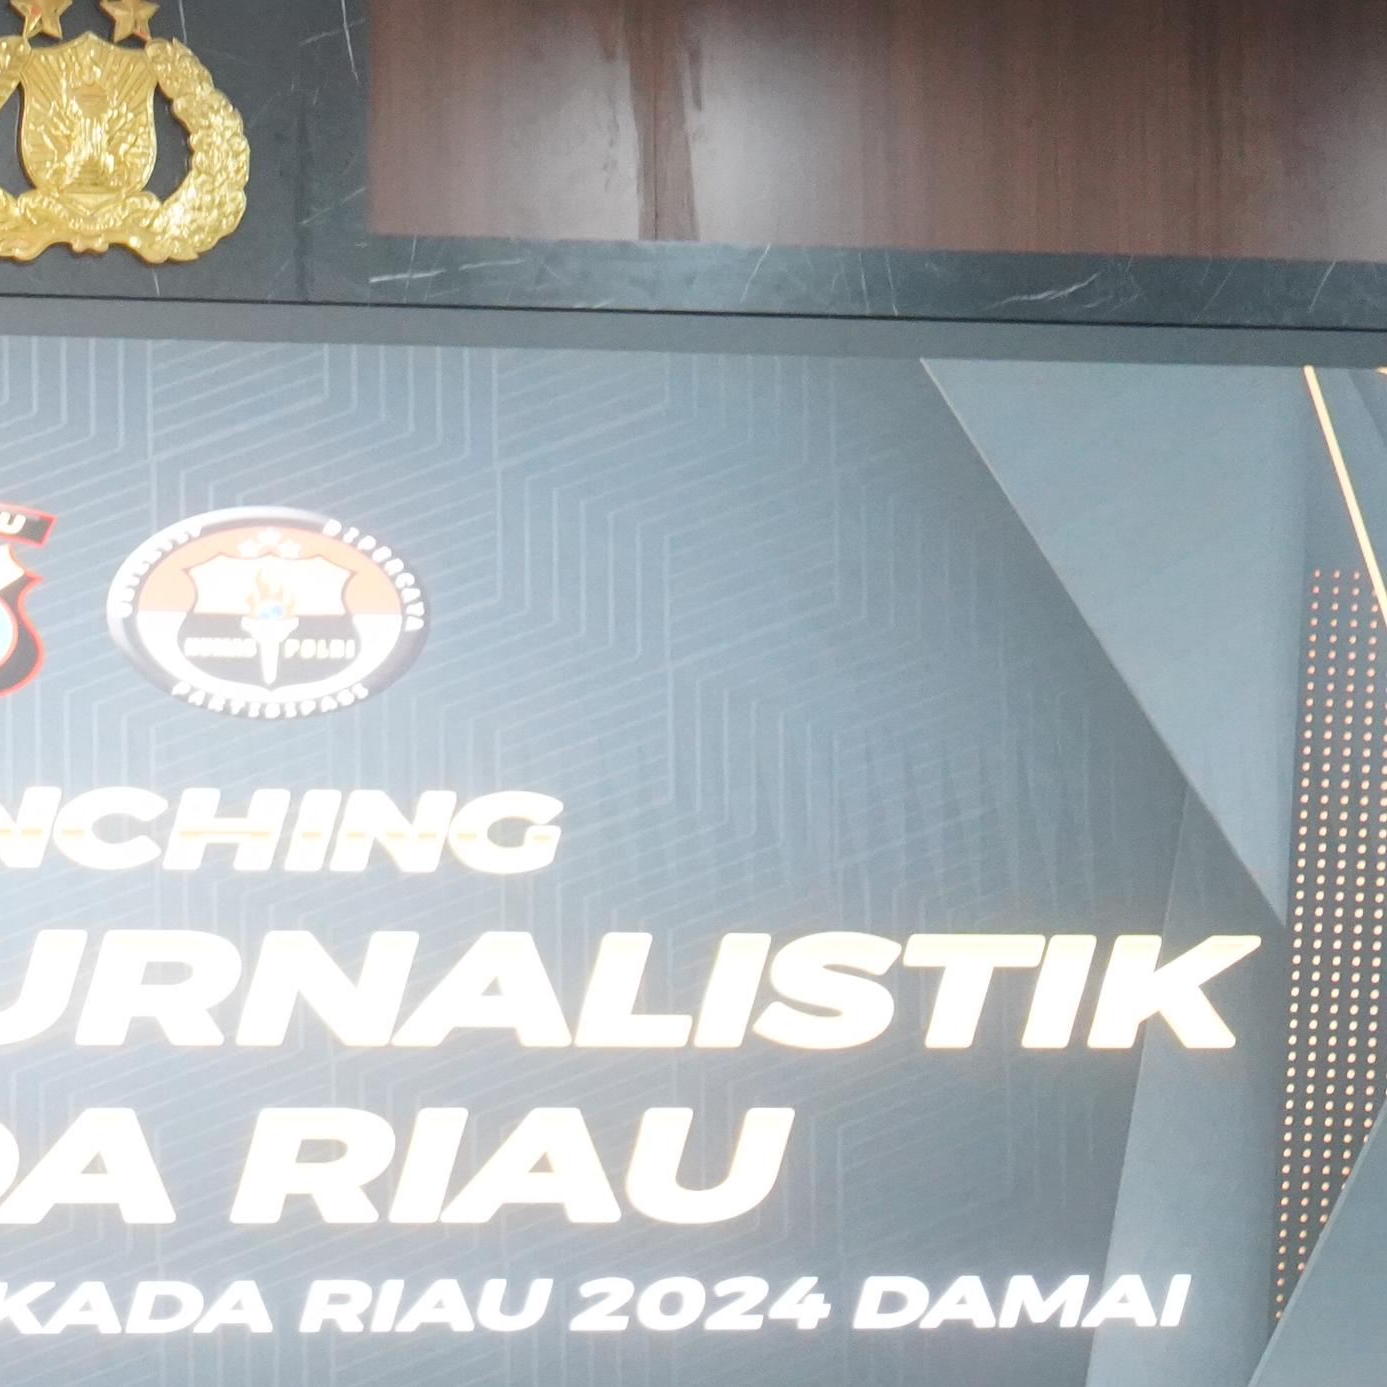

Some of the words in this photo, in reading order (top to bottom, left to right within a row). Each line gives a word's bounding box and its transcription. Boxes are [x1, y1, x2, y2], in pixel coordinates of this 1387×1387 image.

[229, 1106, 797, 1226] RIAU
[300, 1278, 554, 1334] RIAU
[571, 1276, 831, 1332] 2024
[853, 1273, 1191, 1331] DAMAI
